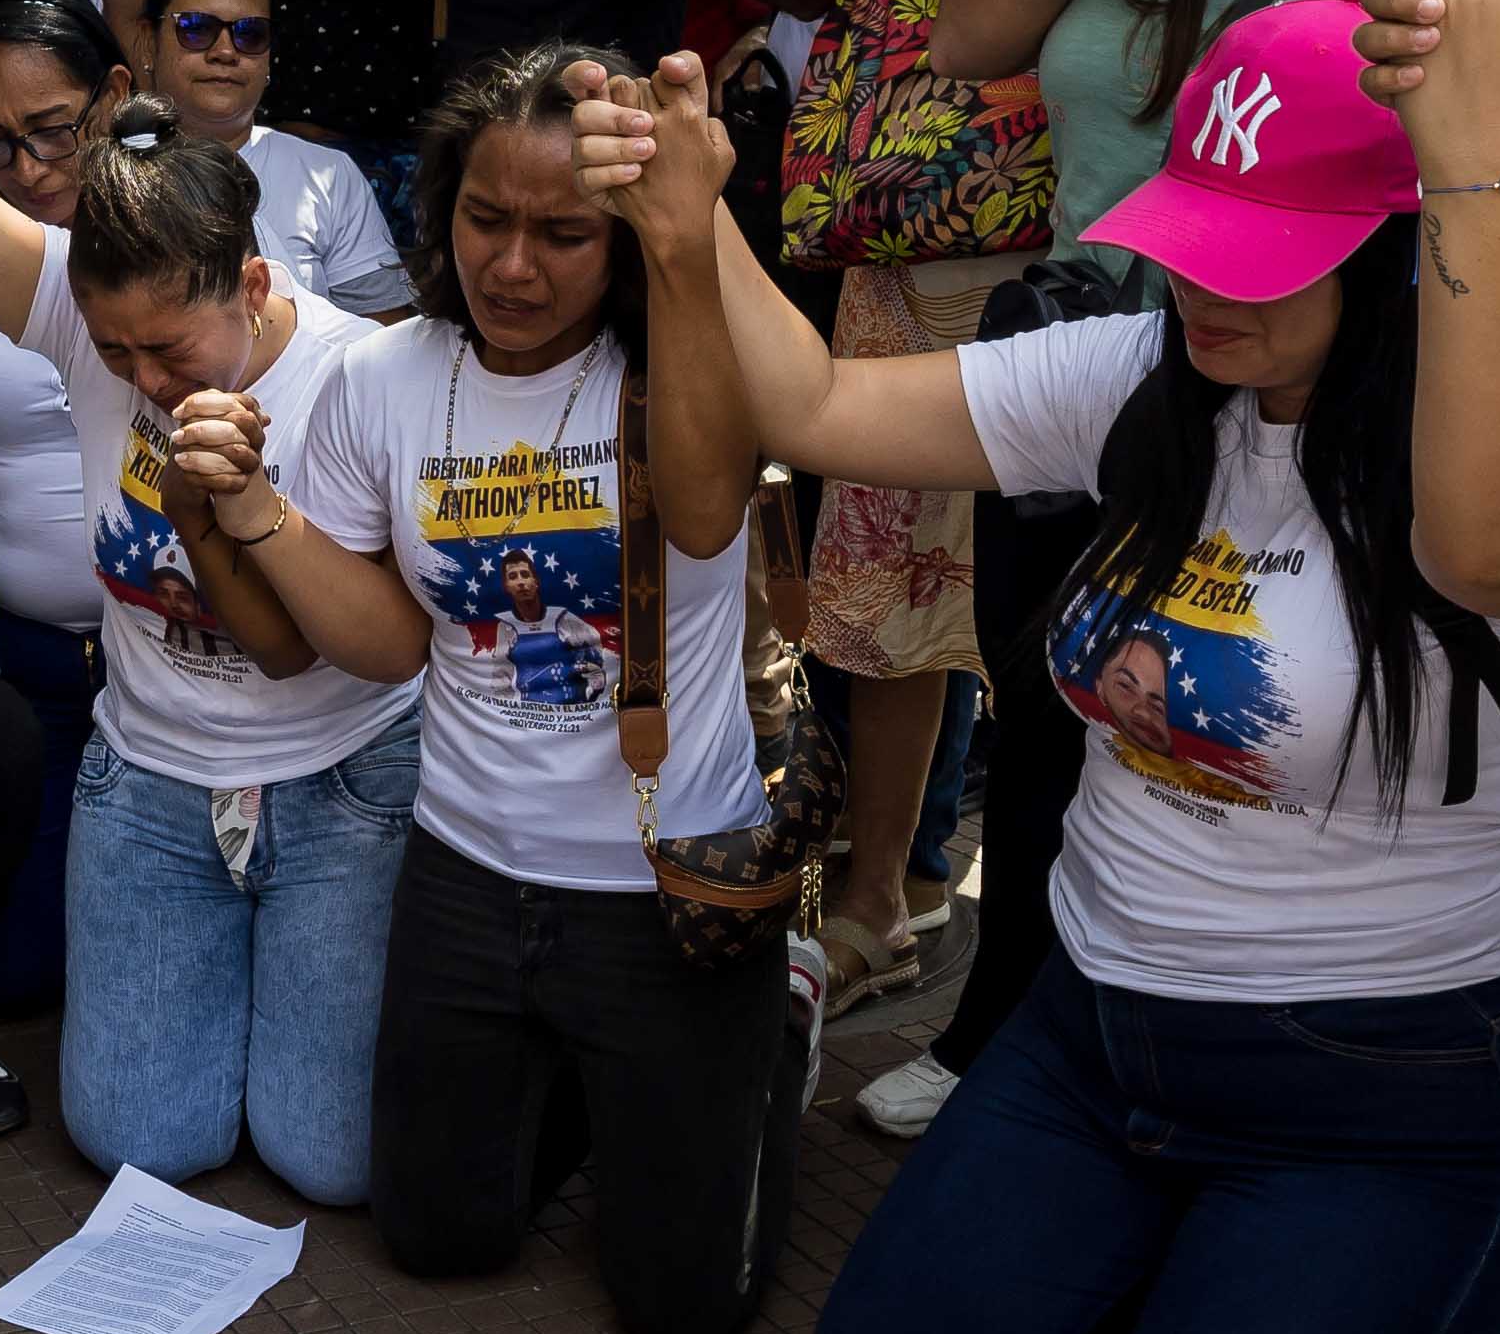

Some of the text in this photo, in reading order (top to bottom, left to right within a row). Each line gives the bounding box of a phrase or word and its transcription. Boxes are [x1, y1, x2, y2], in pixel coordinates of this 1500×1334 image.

[1191, 66, 1281, 175] NY
[419, 456, 483, 481] LIBERTAD
[488, 454, 527, 478] PARA
[436, 485, 534, 522] ANTHONY
[1217, 550, 1244, 574] MI
[574, 701, 600, 712] AMOR
[1144, 785, 1219, 828] PROVERBIOS 21:21
